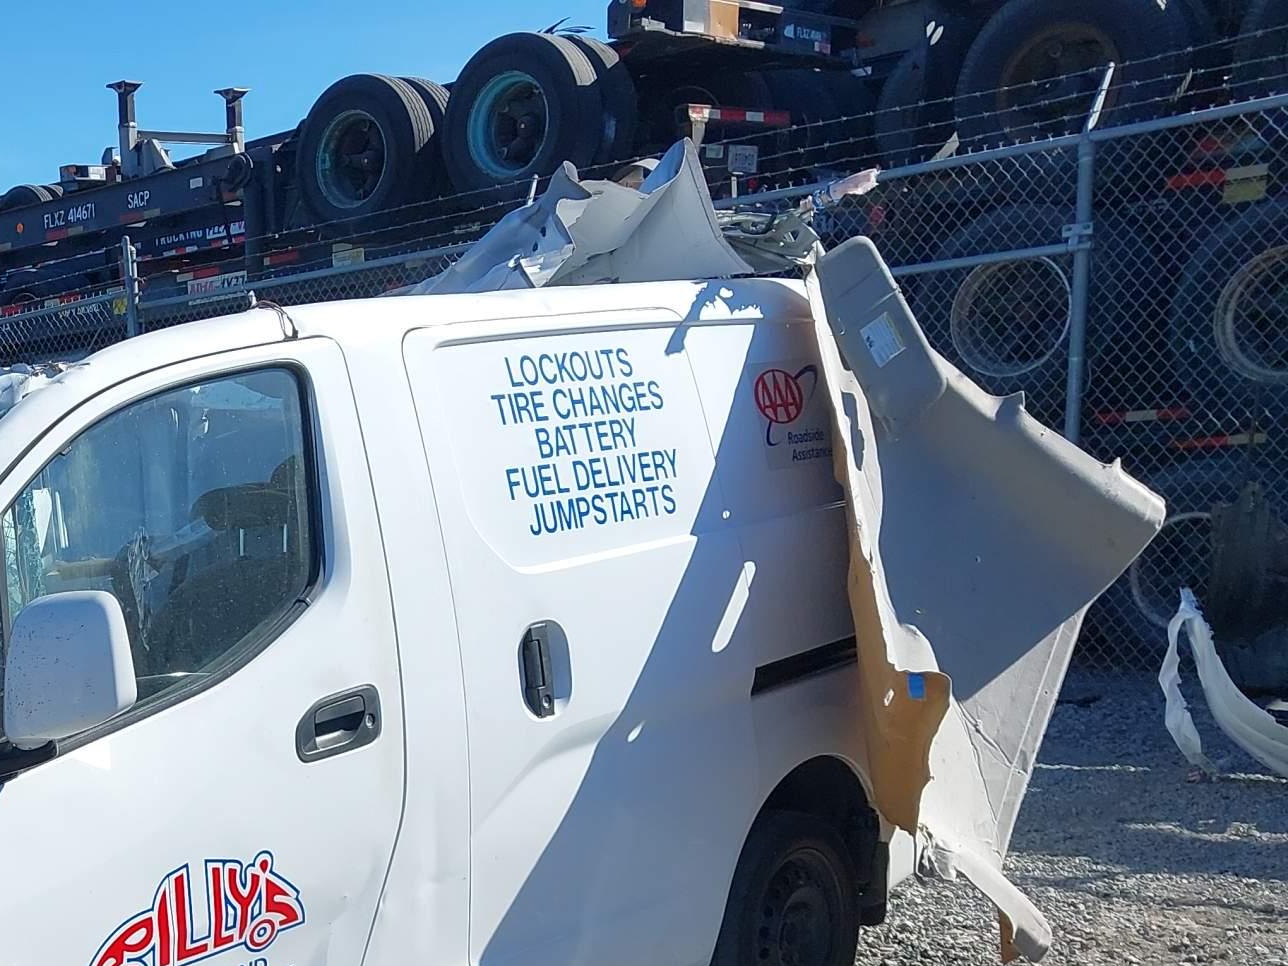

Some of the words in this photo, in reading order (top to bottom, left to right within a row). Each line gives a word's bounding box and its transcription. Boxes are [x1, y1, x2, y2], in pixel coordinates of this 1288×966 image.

[43, 210, 66, 229] FLXZ
[67, 203, 96, 223] 414671
[127, 191, 150, 209] SACP
[503, 347, 633, 388] LOCKOUTS
[491, 390, 549, 425] TIRE
[551, 380, 664, 421] CHANGES
[755, 369, 803, 424] AAA
[534, 418, 637, 460] BATTERY
[787, 429, 825, 445] Roadside
[506, 463, 571, 501] FUEL
[572, 449, 679, 492] DELIVERY
[529, 484, 678, 536] JUMPSTARTS
